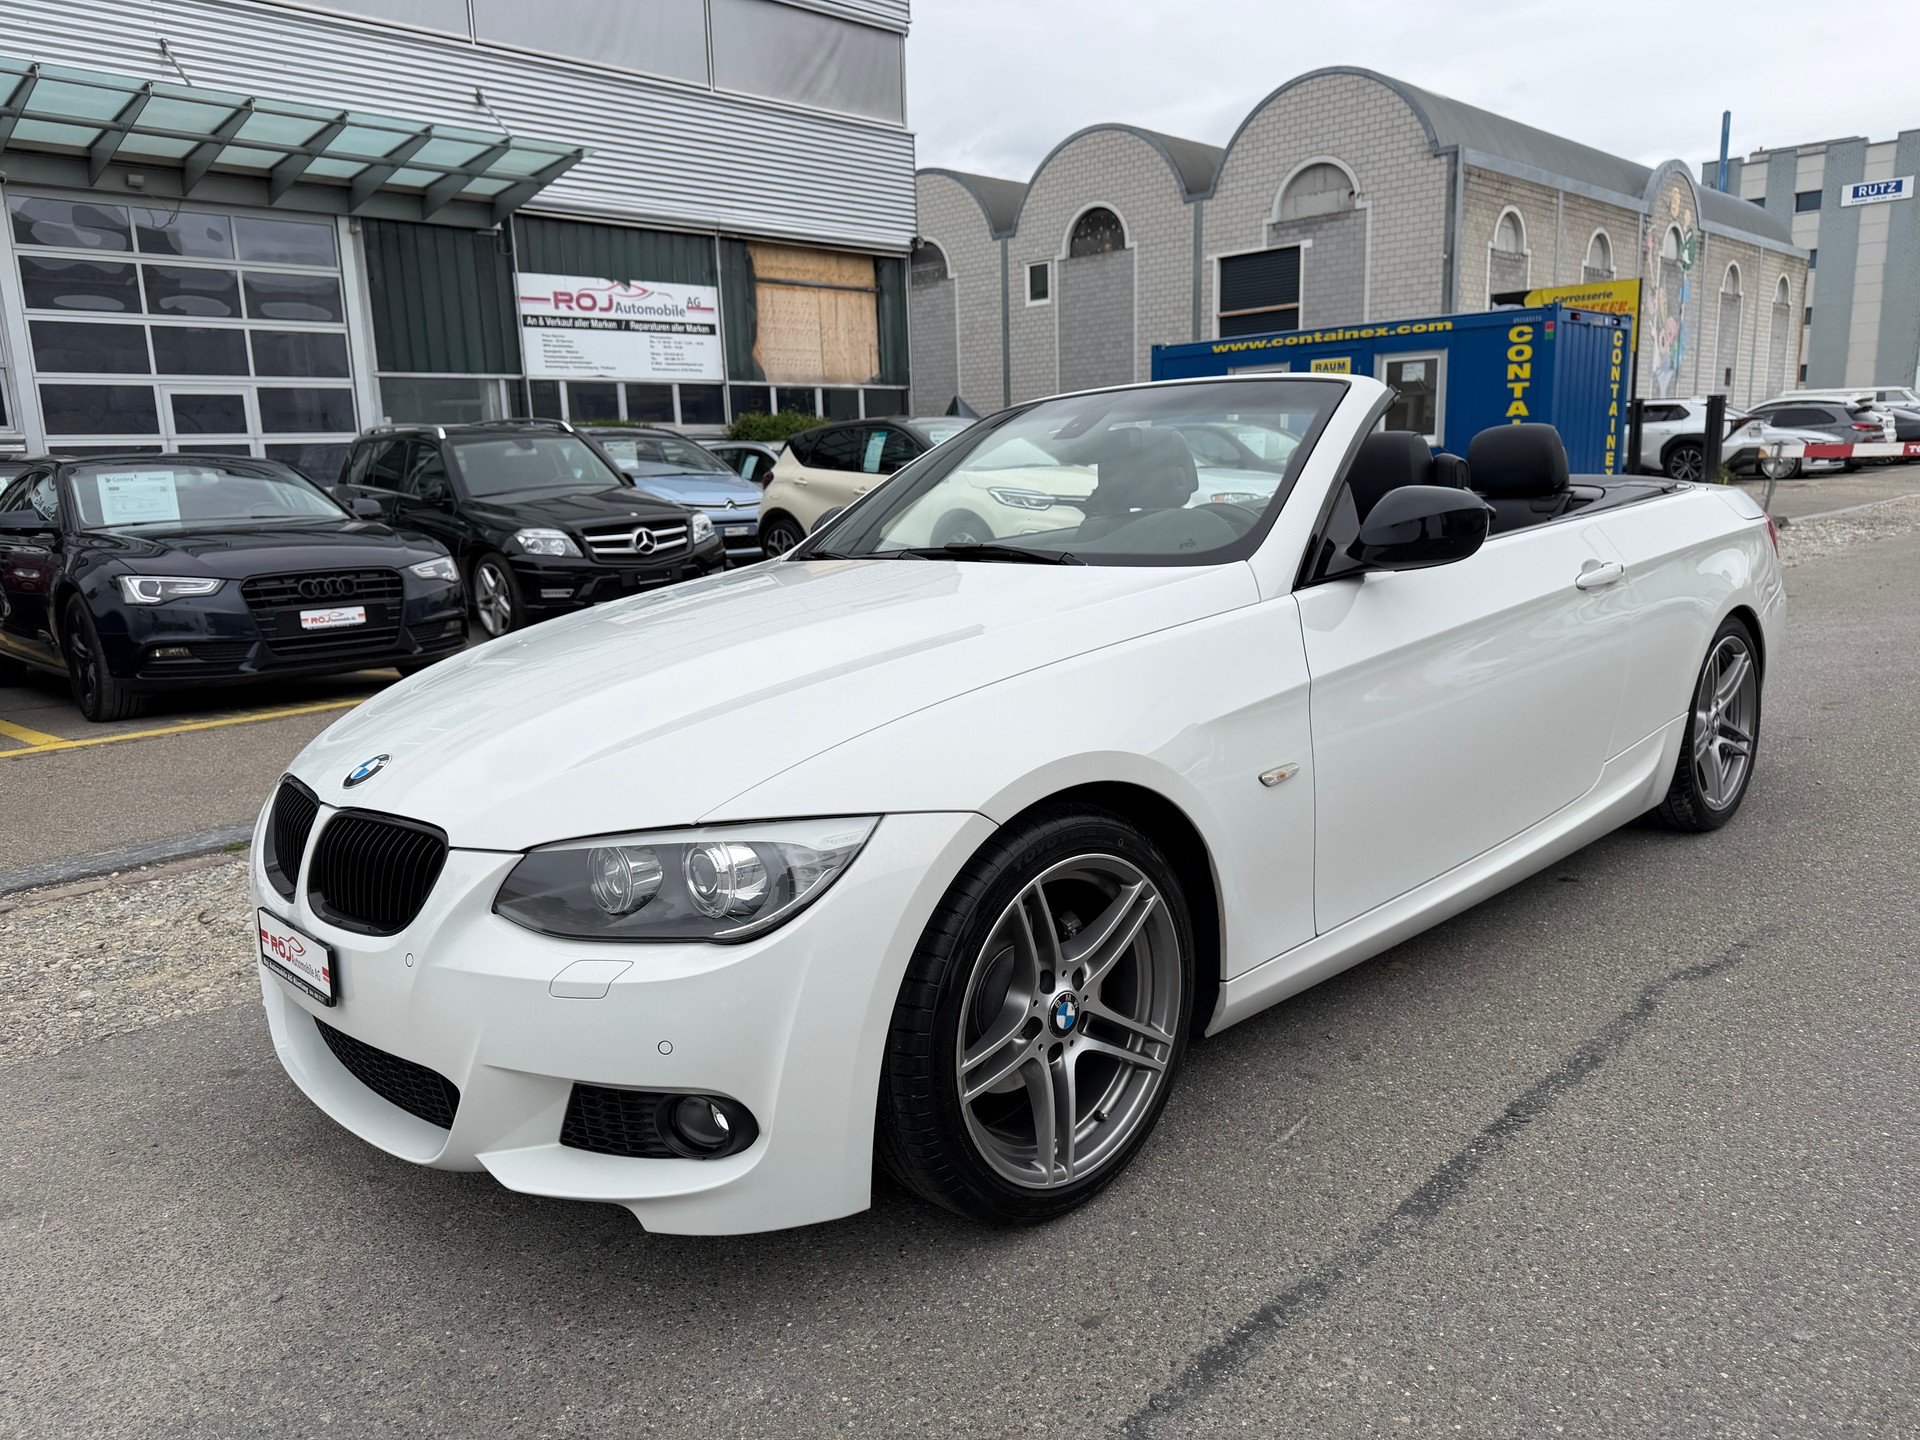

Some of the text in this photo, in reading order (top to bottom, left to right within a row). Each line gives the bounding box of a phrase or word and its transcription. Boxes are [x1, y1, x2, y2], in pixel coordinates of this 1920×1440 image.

[1858, 182, 1897, 197] RUTZ
[553, 291, 701, 317] ROJ Automobile AG
[1553, 290, 1613, 303] Carrosserie
[526, 316, 538, 326] An
[538, 316, 545, 326] &
[545, 316, 573, 327] Verkauf
[574, 318, 589, 328] aller
[590, 319, 618, 329] Marken
[629, 320, 671, 332] Reparaturen
[685, 323, 710, 334] Marken
[1212, 321, 1453, 354] www.containex.com
[1315, 361, 1346, 372] RAUM
[310, 615, 331, 624] ROJ
[270, 934, 322, 982] ROJ Automobile AG
